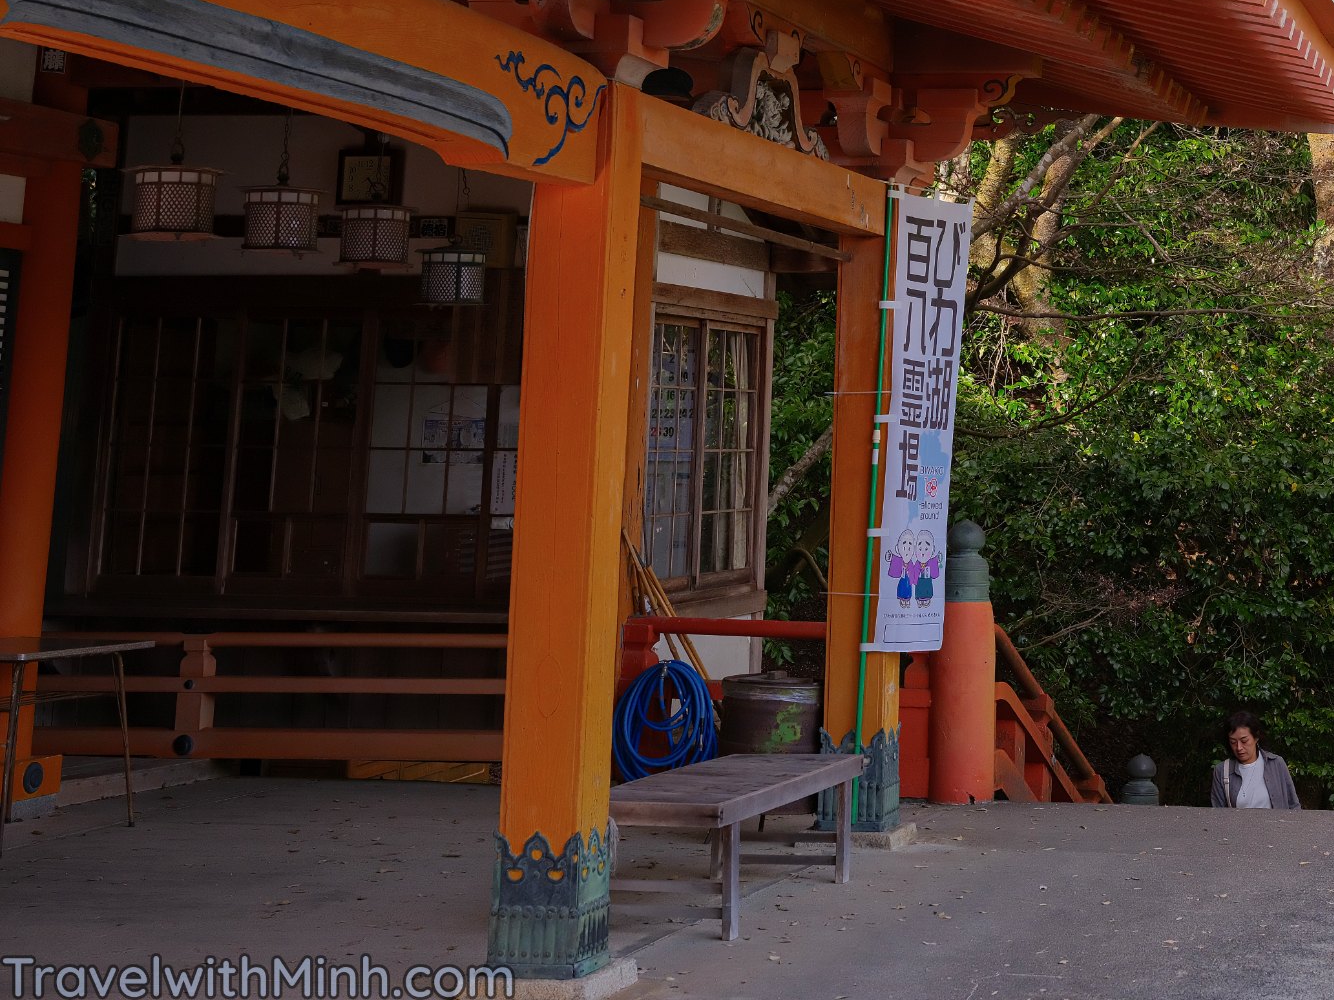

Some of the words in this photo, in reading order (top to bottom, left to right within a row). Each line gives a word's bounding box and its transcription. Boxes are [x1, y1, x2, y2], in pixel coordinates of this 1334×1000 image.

[895, 215, 935, 502] 百八霊場
[923, 219, 966, 430] びわ湖
[920, 510, 940, 521] ground
